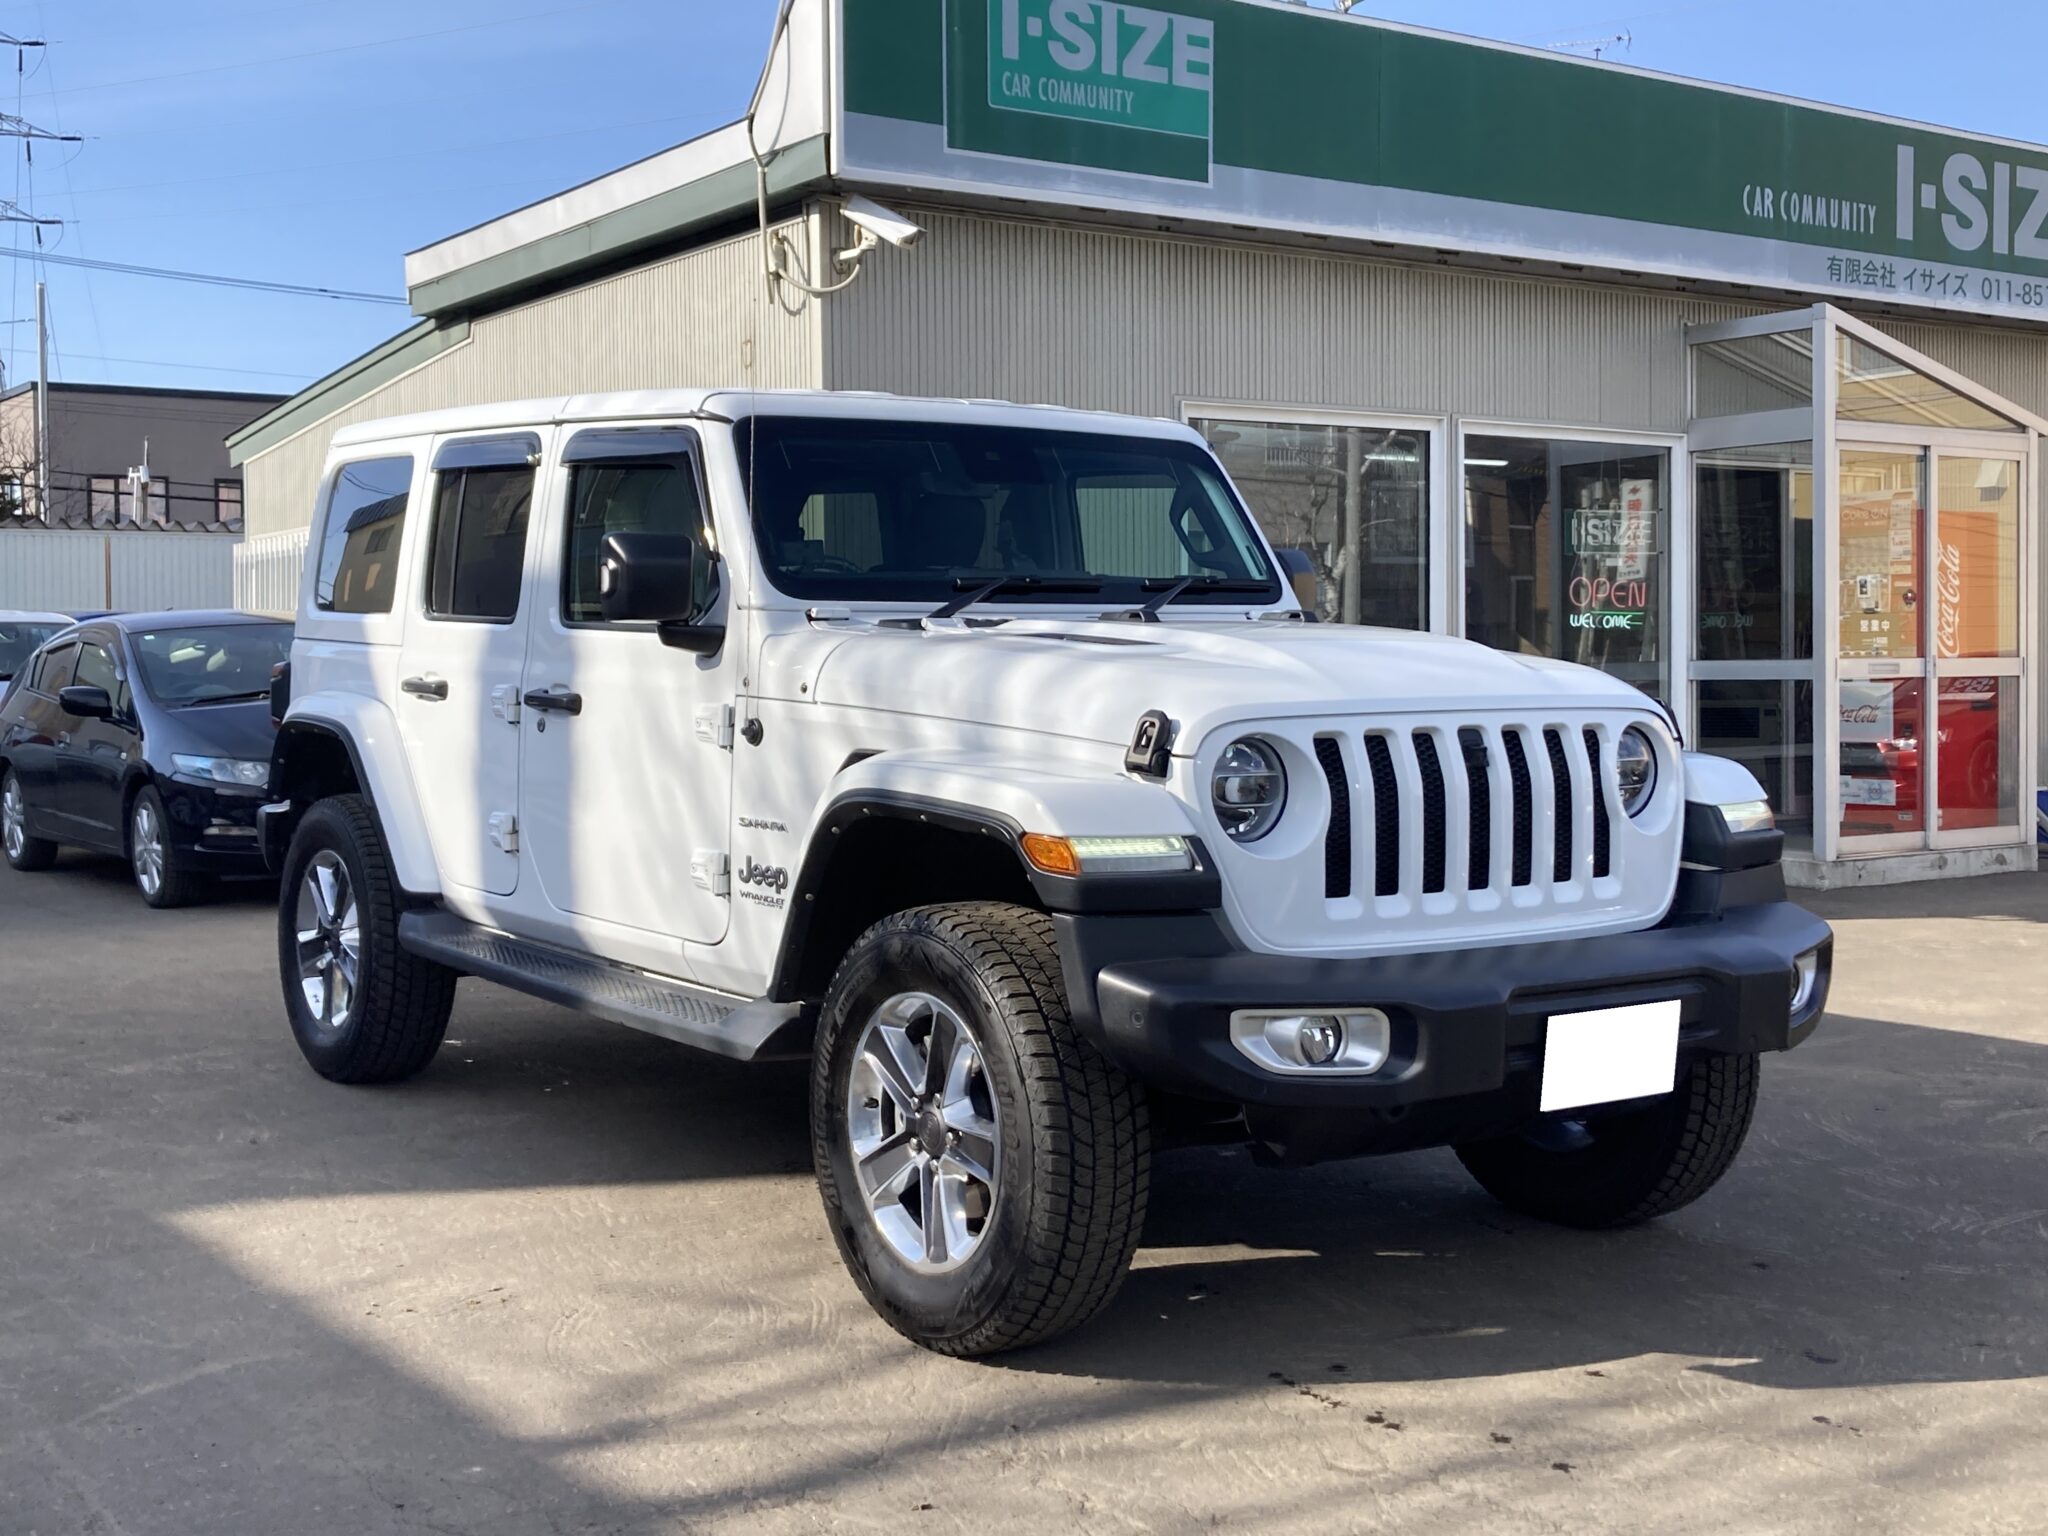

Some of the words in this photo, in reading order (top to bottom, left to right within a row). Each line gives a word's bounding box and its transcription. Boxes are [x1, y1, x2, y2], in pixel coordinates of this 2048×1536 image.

[1002, 71, 1031, 99] CAR
[1038, 77, 1134, 114] COMMUNITY
[1743, 184, 1774, 220] CAR
[1780, 190, 1877, 235] COMMUNITY
[1827, 255, 1896, 289] 有限会社
[1903, 267, 1969, 297] イサイズ
[1981, 277, 2048, 306] 011-85
[1569, 576, 1647, 608] OPEN
[1569, 612, 1643, 630] WELCOME
[738, 816, 789, 833] SAHARA
[738, 855, 789, 895] Jeep
